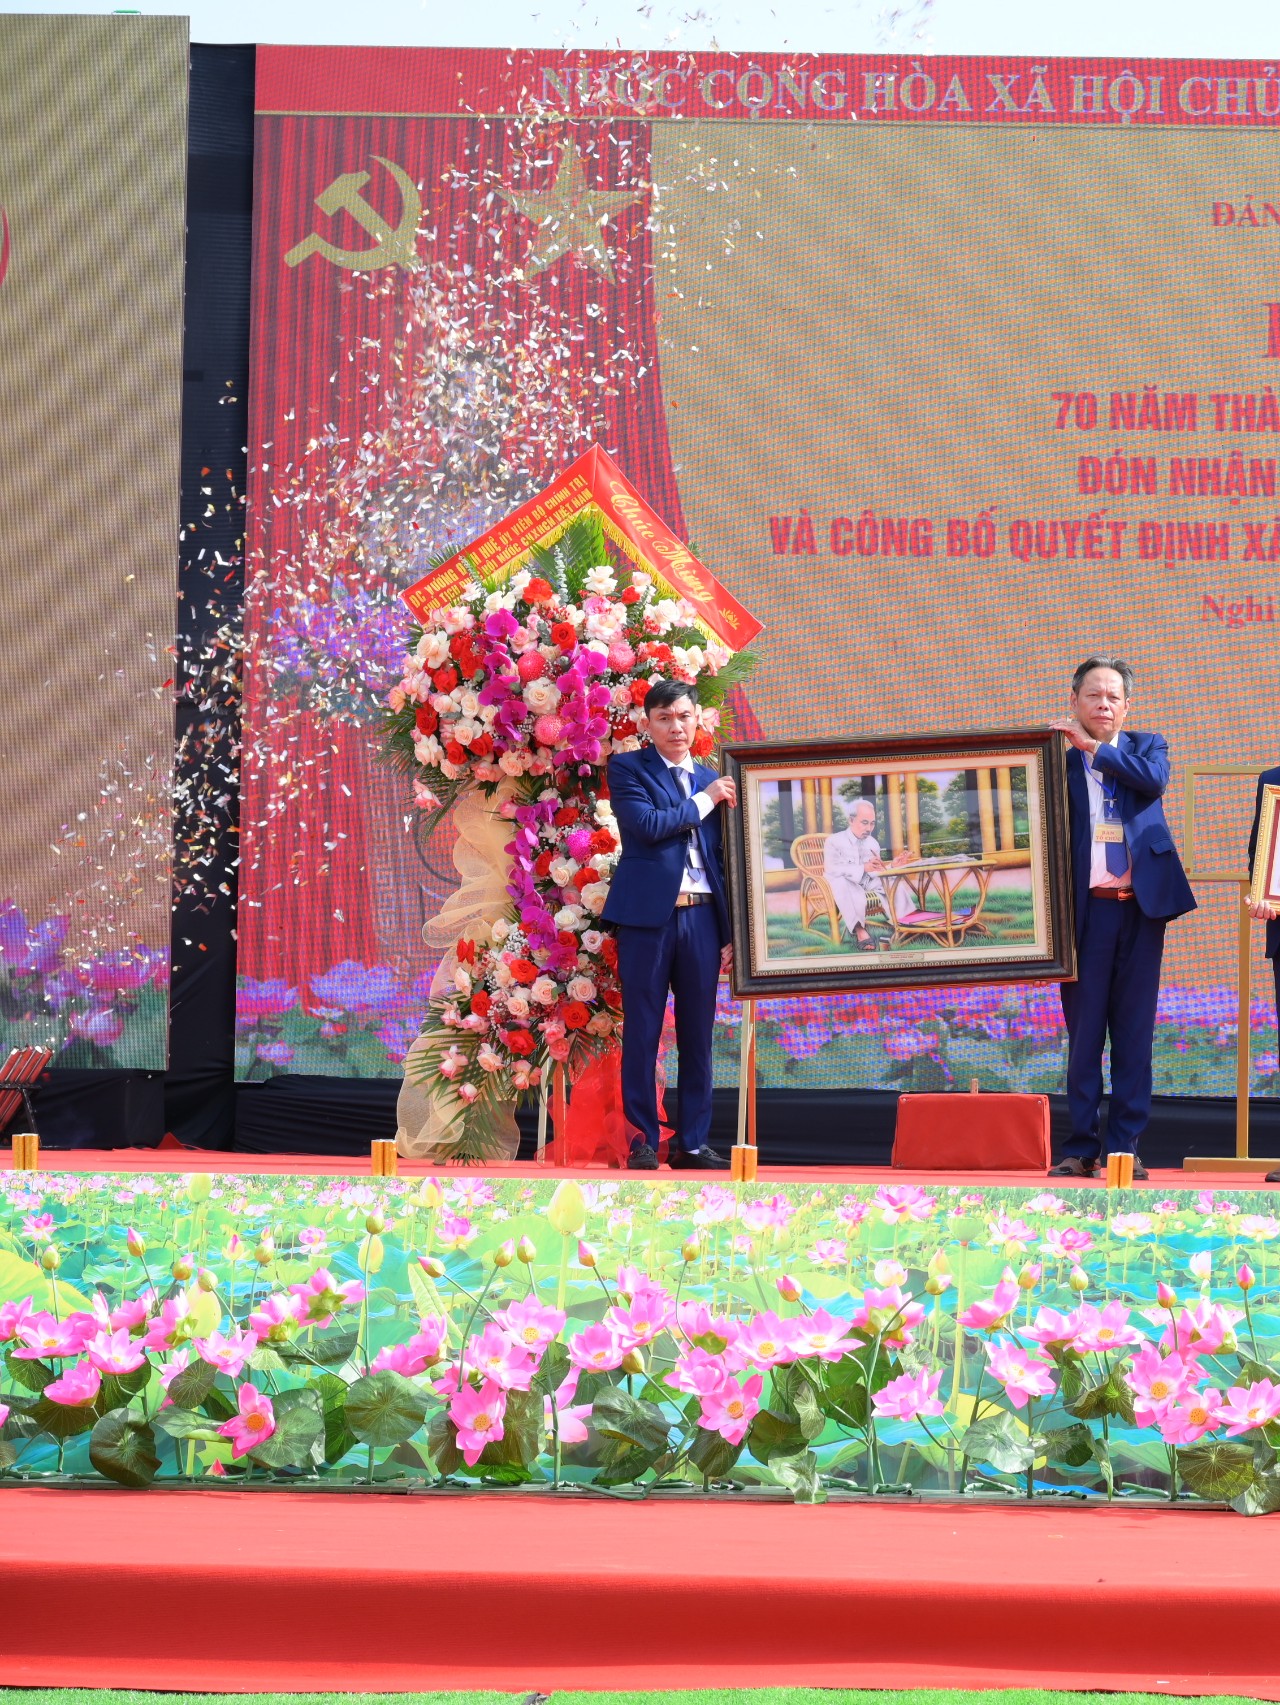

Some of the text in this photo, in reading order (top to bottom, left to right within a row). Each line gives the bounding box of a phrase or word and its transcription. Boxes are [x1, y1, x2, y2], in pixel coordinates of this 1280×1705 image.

[701, 63, 848, 119] CỘNG
[860, 61, 973, 112] HÒA
[985, 65, 1055, 113] XÃ
[1069, 69, 1165, 123] HỘI
[1051, 391, 1098, 431] 70
[1110, 385, 1199, 432] NĂM
[552, 502, 574, 522] VIỆT
[571, 488, 593, 508] NAM
[1077, 448, 1156, 495] ĐÓN
[1170, 450, 1276, 506] NHẬN
[479, 536, 502, 559] HUỆ
[510, 515, 534, 536] VIÊN
[531, 504, 548, 521] BỘ
[544, 487, 572, 510] CHÍNH
[568, 474, 589, 492] TRỊ
[609, 480, 715, 603] Chúc Mừng
[769, 508, 818, 556] VÀ
[830, 509, 933, 558] CÔNG
[946, 505, 998, 559] BỐ
[1009, 508, 1128, 563] QUYẾT
[1138, 520, 1230, 569] ĐỊNH
[1200, 593, 1275, 629] Nghi
